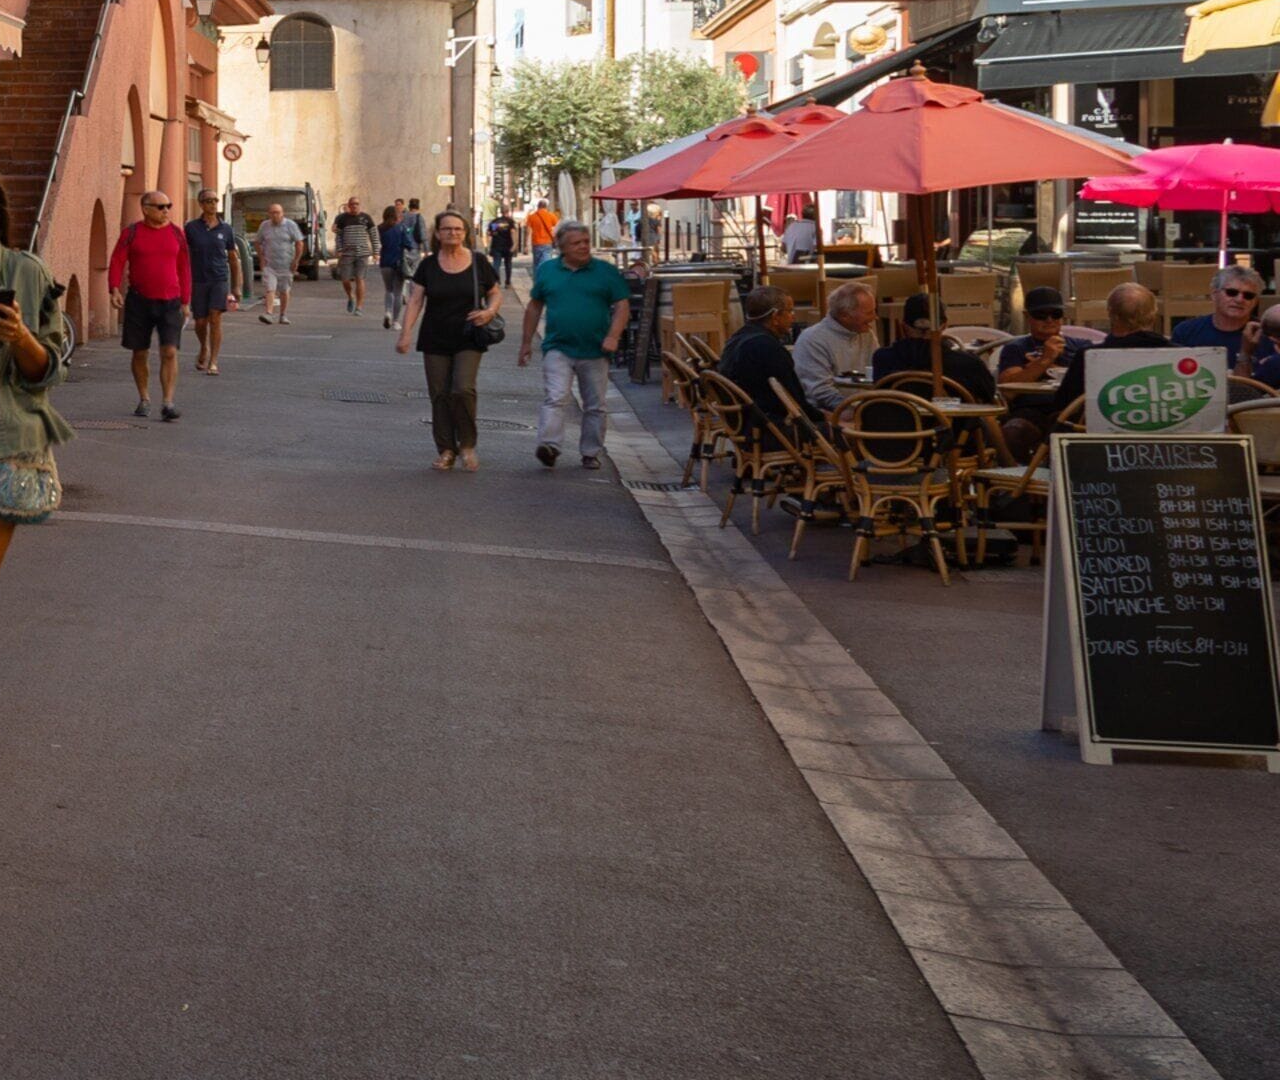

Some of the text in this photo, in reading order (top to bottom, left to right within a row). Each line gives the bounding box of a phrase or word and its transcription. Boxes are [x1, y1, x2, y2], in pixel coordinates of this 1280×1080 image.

[1108, 365, 1216, 405] relais
[1110, 401, 1186, 425] colis
[1105, 444, 1217, 469] HORAIRES
[1072, 482, 1117, 496] LUNDI
[1074, 498, 1122, 516] MARDI
[1075, 518, 1154, 535] MERCREDI
[1077, 537, 1126, 553] JEUDI
[1080, 556, 1152, 574] VENDREDI
[1081, 575, 1153, 597] SAMEDI
[1084, 595, 1170, 617] DIMANCHE
[1088, 639, 1139, 656] JOURS
